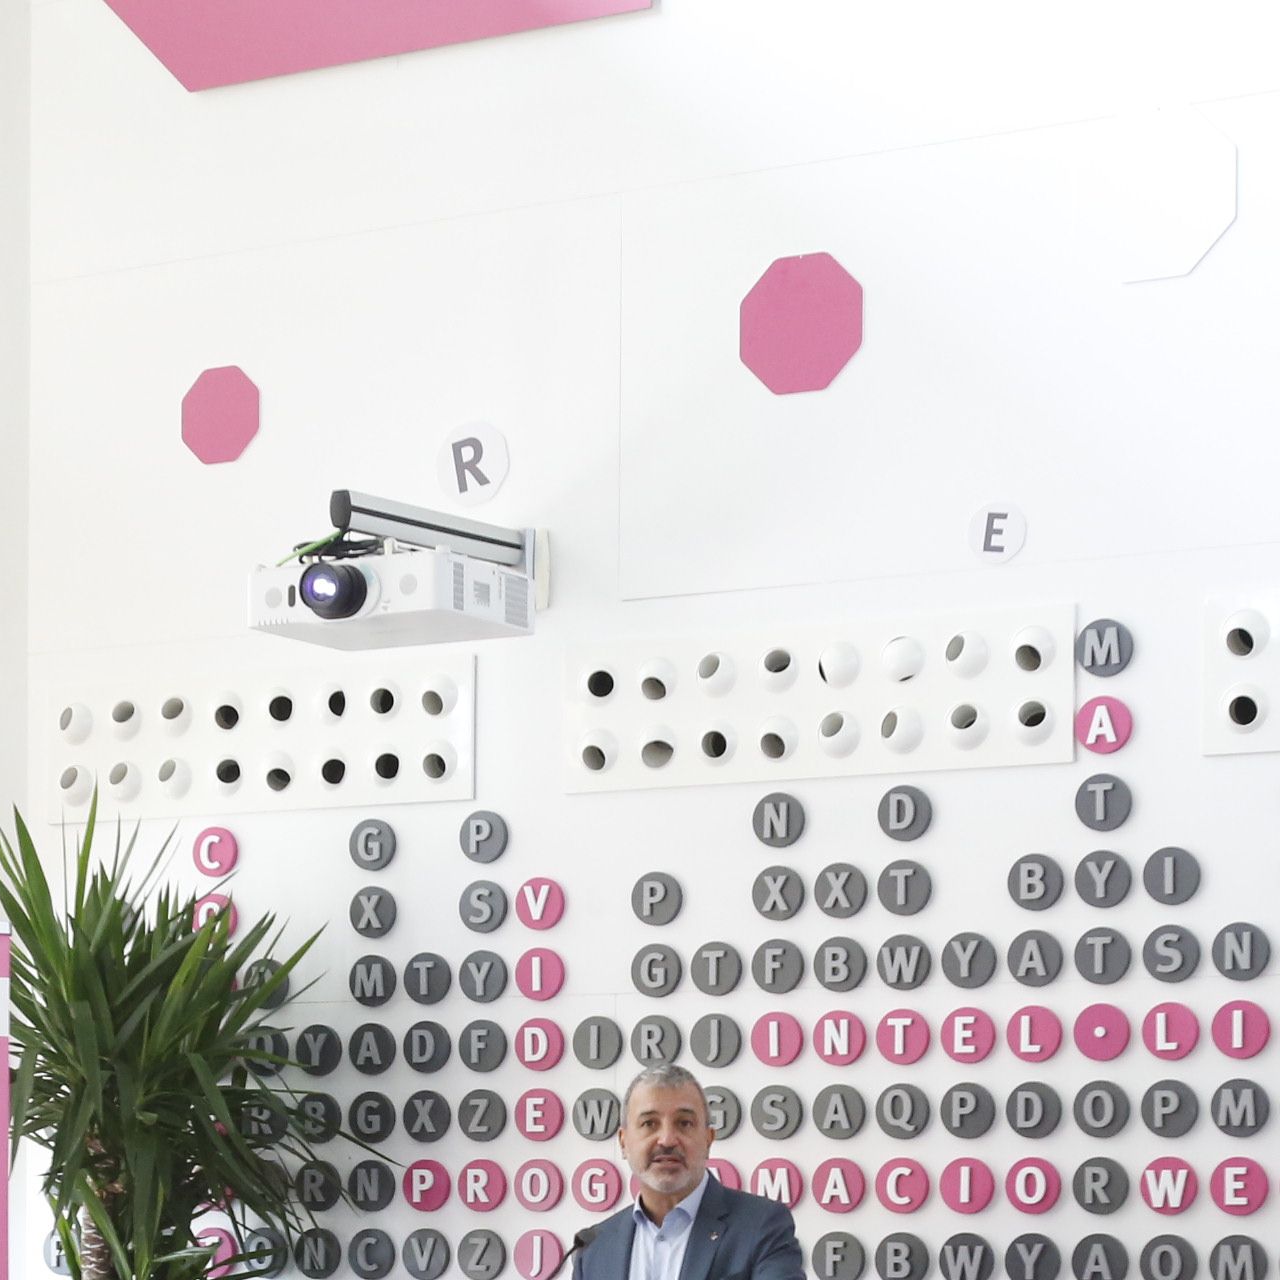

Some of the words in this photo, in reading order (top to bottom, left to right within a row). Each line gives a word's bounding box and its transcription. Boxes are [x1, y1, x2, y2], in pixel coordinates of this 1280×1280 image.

[452, 435, 491, 494] R
[981, 511, 1009, 553] E
[357, 827, 384, 862] G
[469, 819, 490, 854] P
